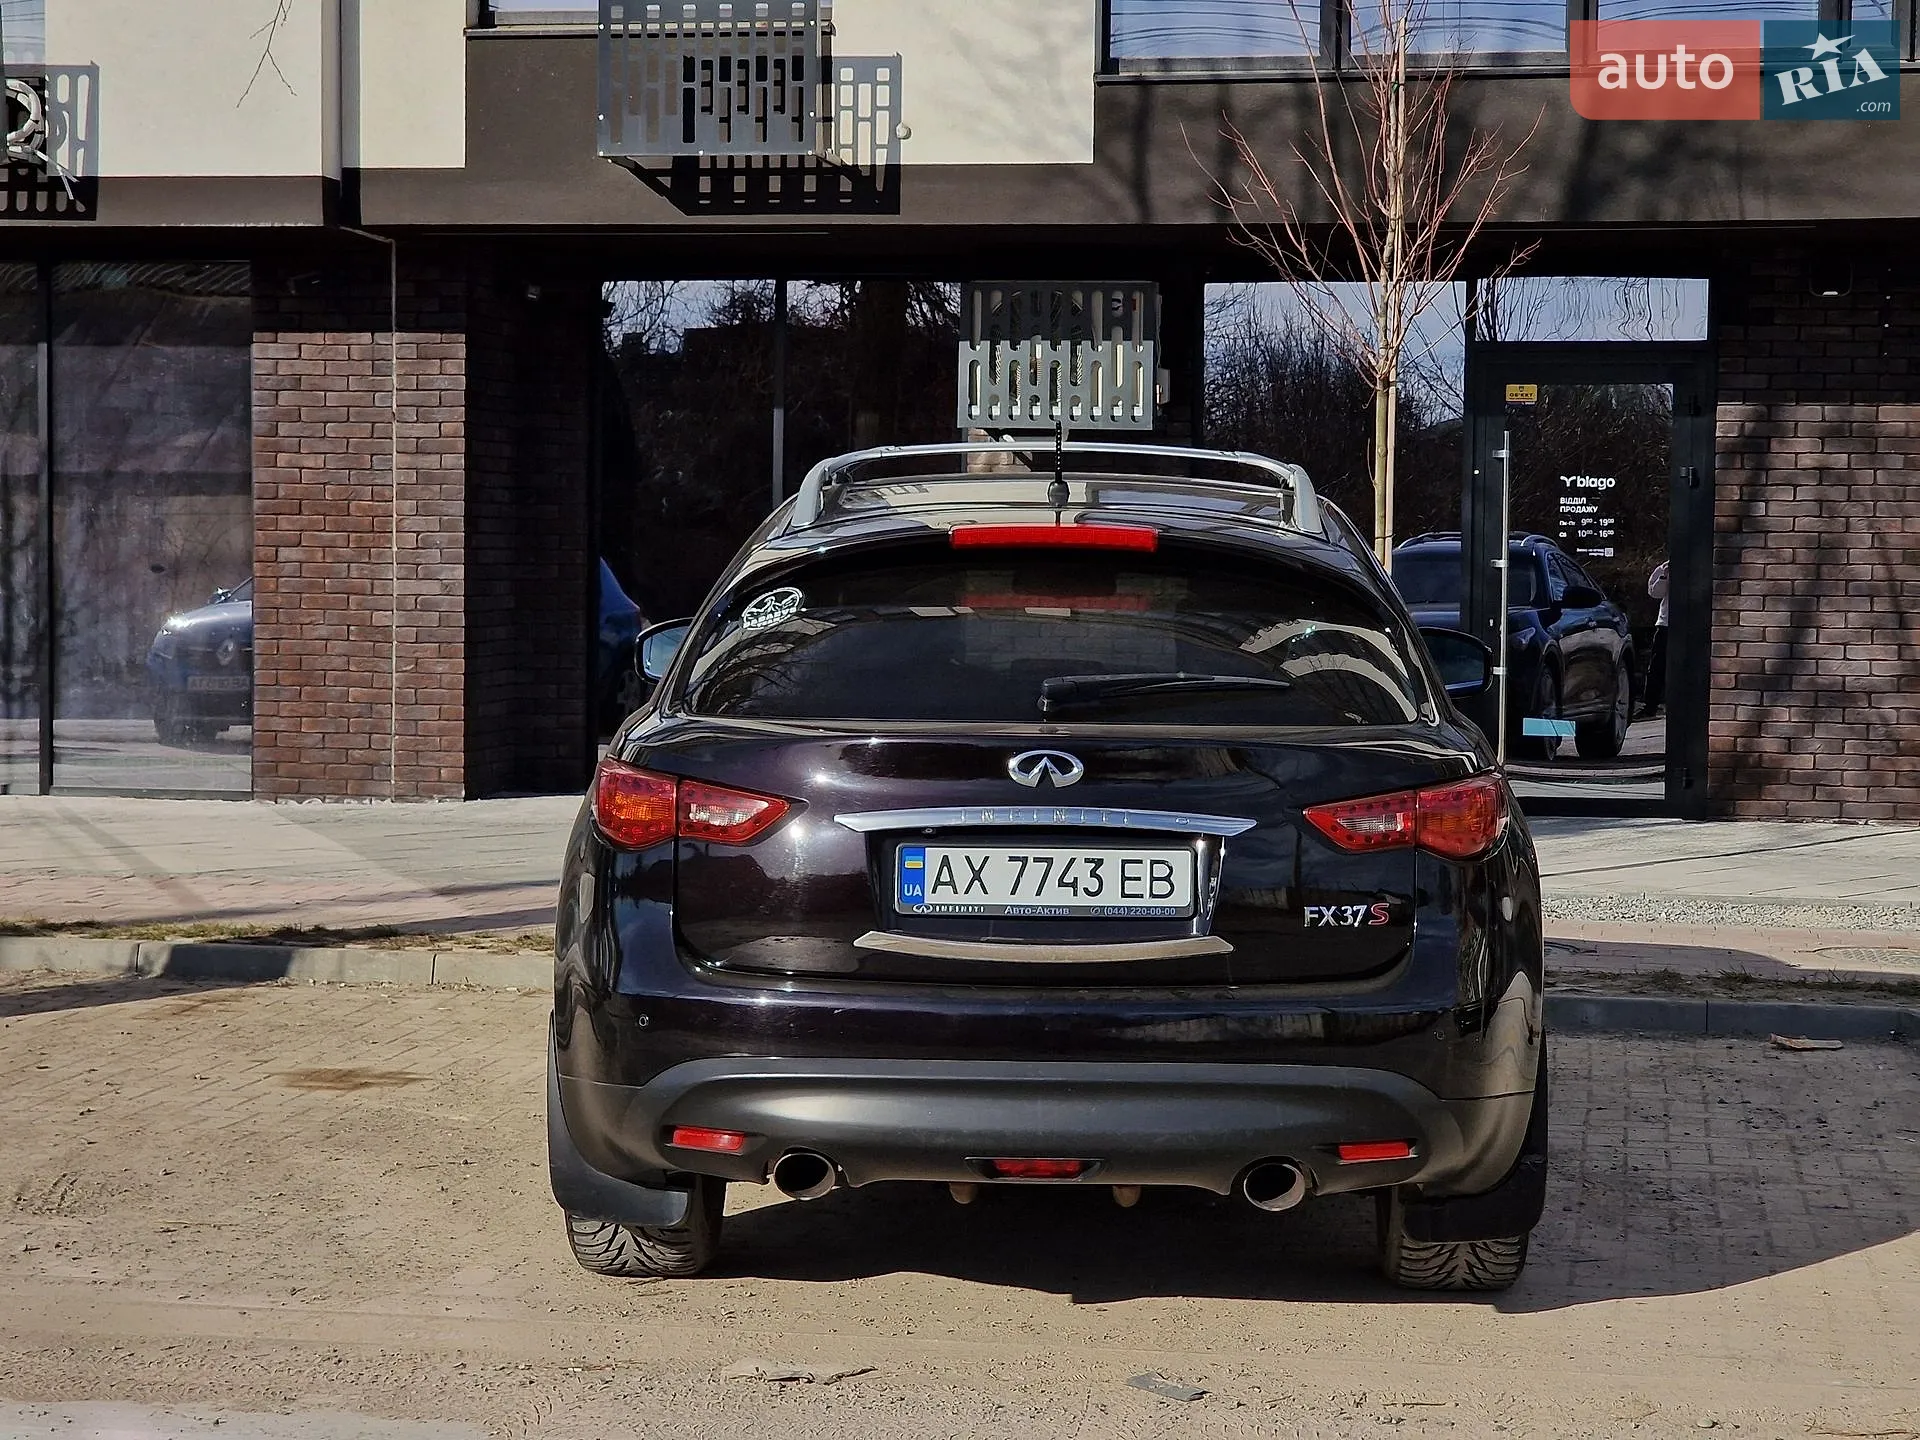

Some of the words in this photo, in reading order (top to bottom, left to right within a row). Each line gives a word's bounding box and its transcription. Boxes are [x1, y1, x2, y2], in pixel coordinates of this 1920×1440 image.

[1576, 475, 1616, 491] blago
[1559, 497, 1587, 505] ВІДДІЛ
[1559, 505, 1599, 514] ПРОДАЖУ
[960, 808, 1129, 824] INFINITI
[931, 854, 990, 895] AX
[1007, 855, 1105, 897] 7743
[1120, 858, 1175, 899] EB
[904, 884, 923, 896] UA
[935, 905, 985, 913] INFINITI
[1004, 905, 1071, 915] Авто-Актив
[1104, 906, 1128, 916] (044)
